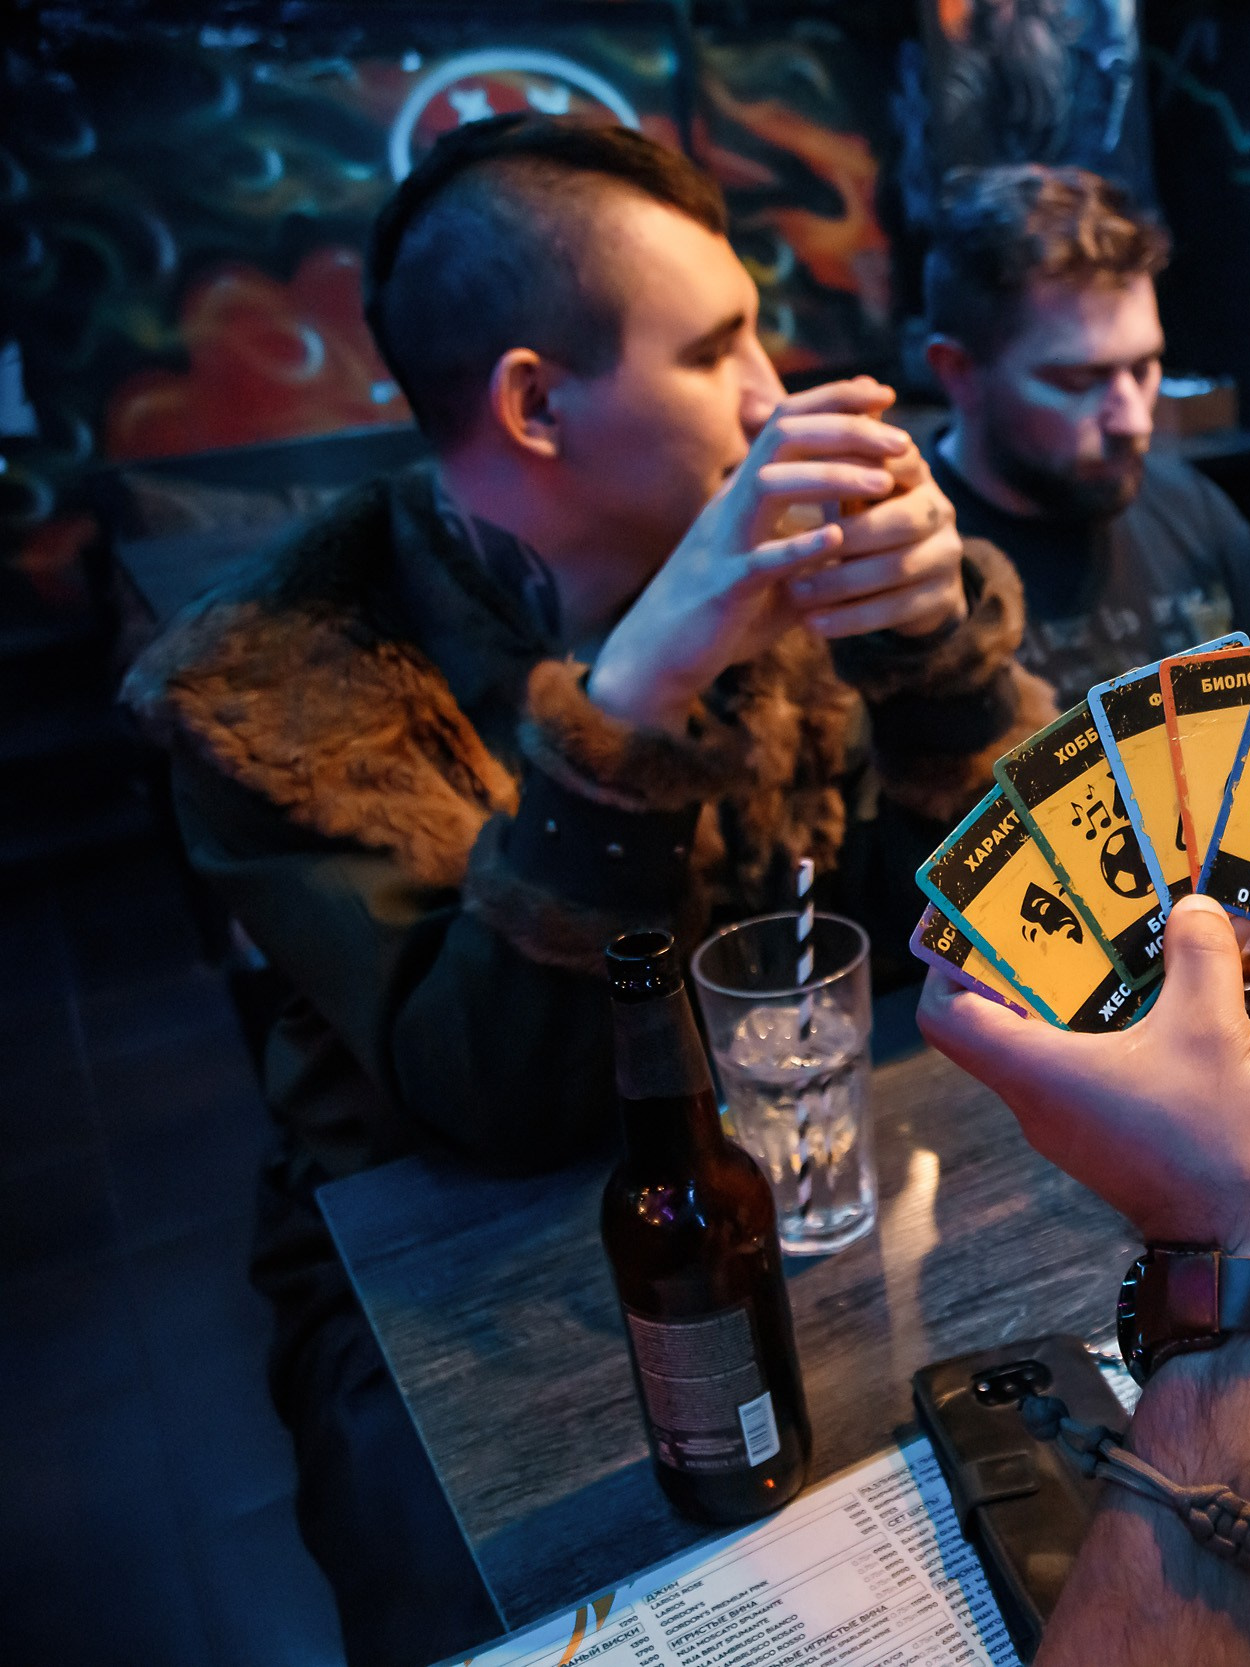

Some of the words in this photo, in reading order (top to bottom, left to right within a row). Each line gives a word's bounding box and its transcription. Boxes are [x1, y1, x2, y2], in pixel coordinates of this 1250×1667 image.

[1054, 727, 1099, 766] ХОББ
[964, 809, 1020, 873] ХАРАКТ
[1098, 983, 1131, 1022] ЖЕС
[647, 1582, 679, 1601] ДЖИН
[602, 1626, 640, 1650] ВИСКИ
[672, 1616, 727, 1647] ИГРИСТЫЕ
[730, 1601, 758, 1618] ВИНА
[697, 1623, 738, 1646] MOSCATO
[740, 1600, 783, 1624] SPUMANTE
[702, 1642, 724, 1655] BRUT
[726, 1618, 770, 1643] SPUMANTE
[778, 1634, 806, 1651] ROSSO
[805, 1621, 859, 1653] ИГРИСТЫЕ
[860, 1605, 888, 1622] ВИНА
[723, 1641, 770, 1667] AMBRUSCO
[772, 1623, 805, 1642] ROSATO
